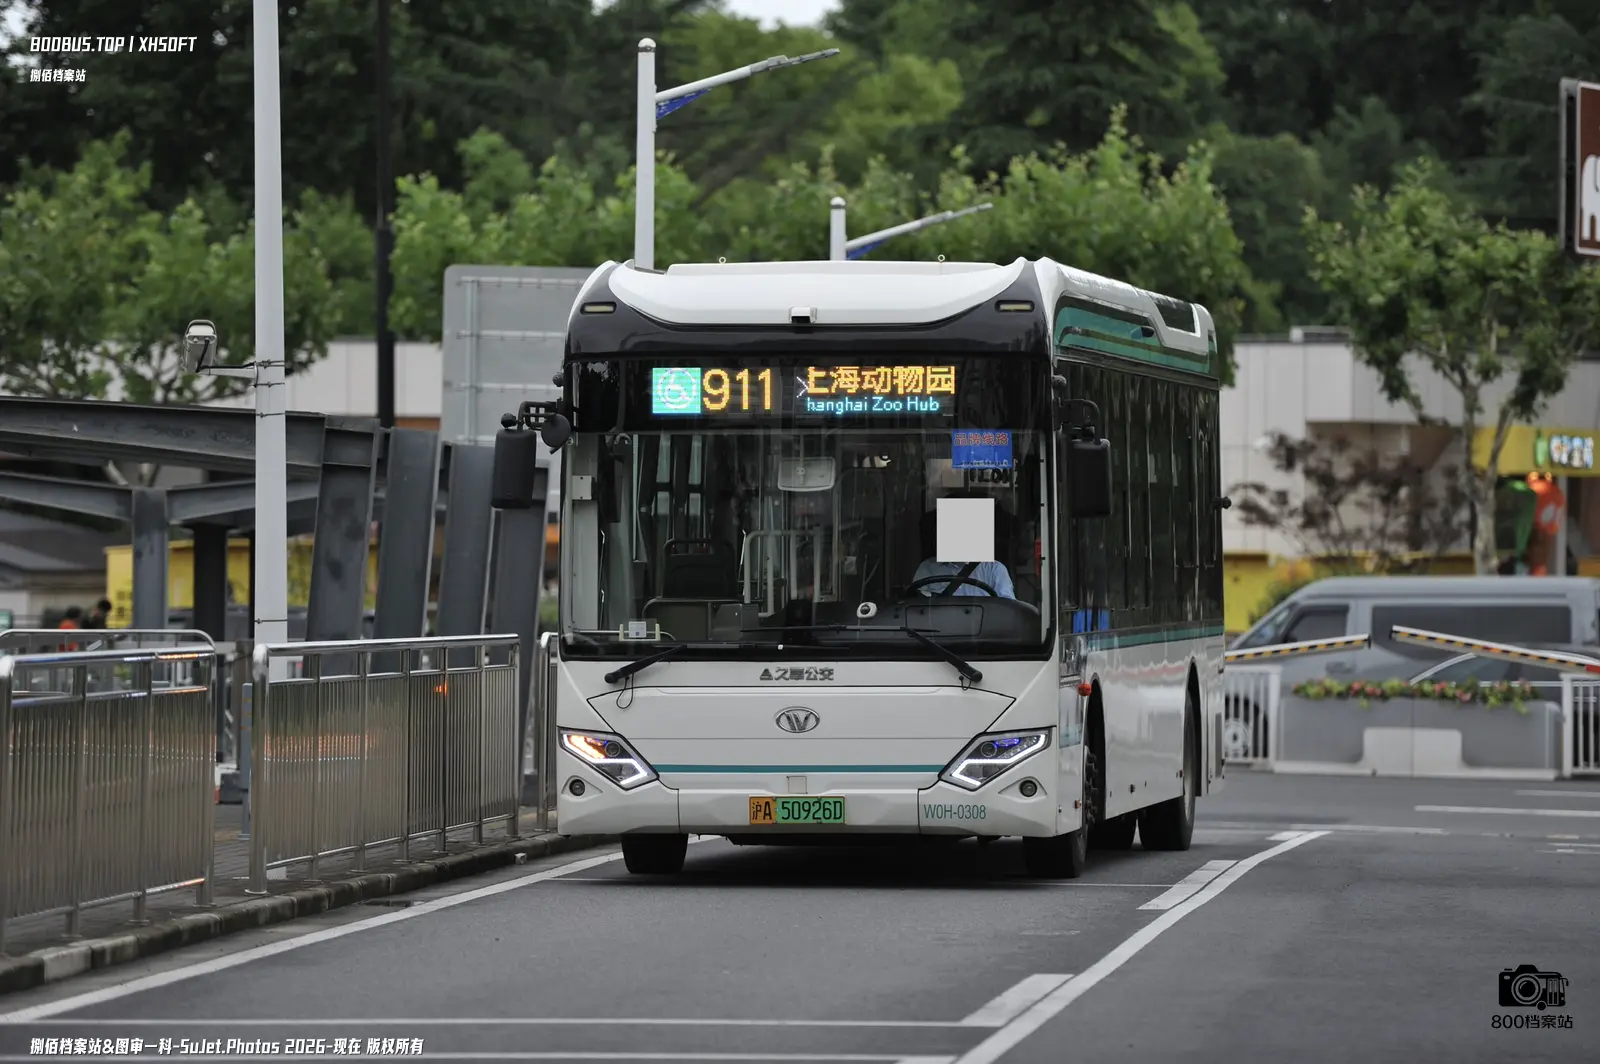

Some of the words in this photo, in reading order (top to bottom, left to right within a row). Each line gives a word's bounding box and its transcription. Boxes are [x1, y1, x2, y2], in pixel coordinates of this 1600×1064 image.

[702, 368, 771, 410] 911
[807, 365, 955, 394] 上海动物园
[872, 396, 904, 412] Zoo
[907, 396, 940, 412] Hub
